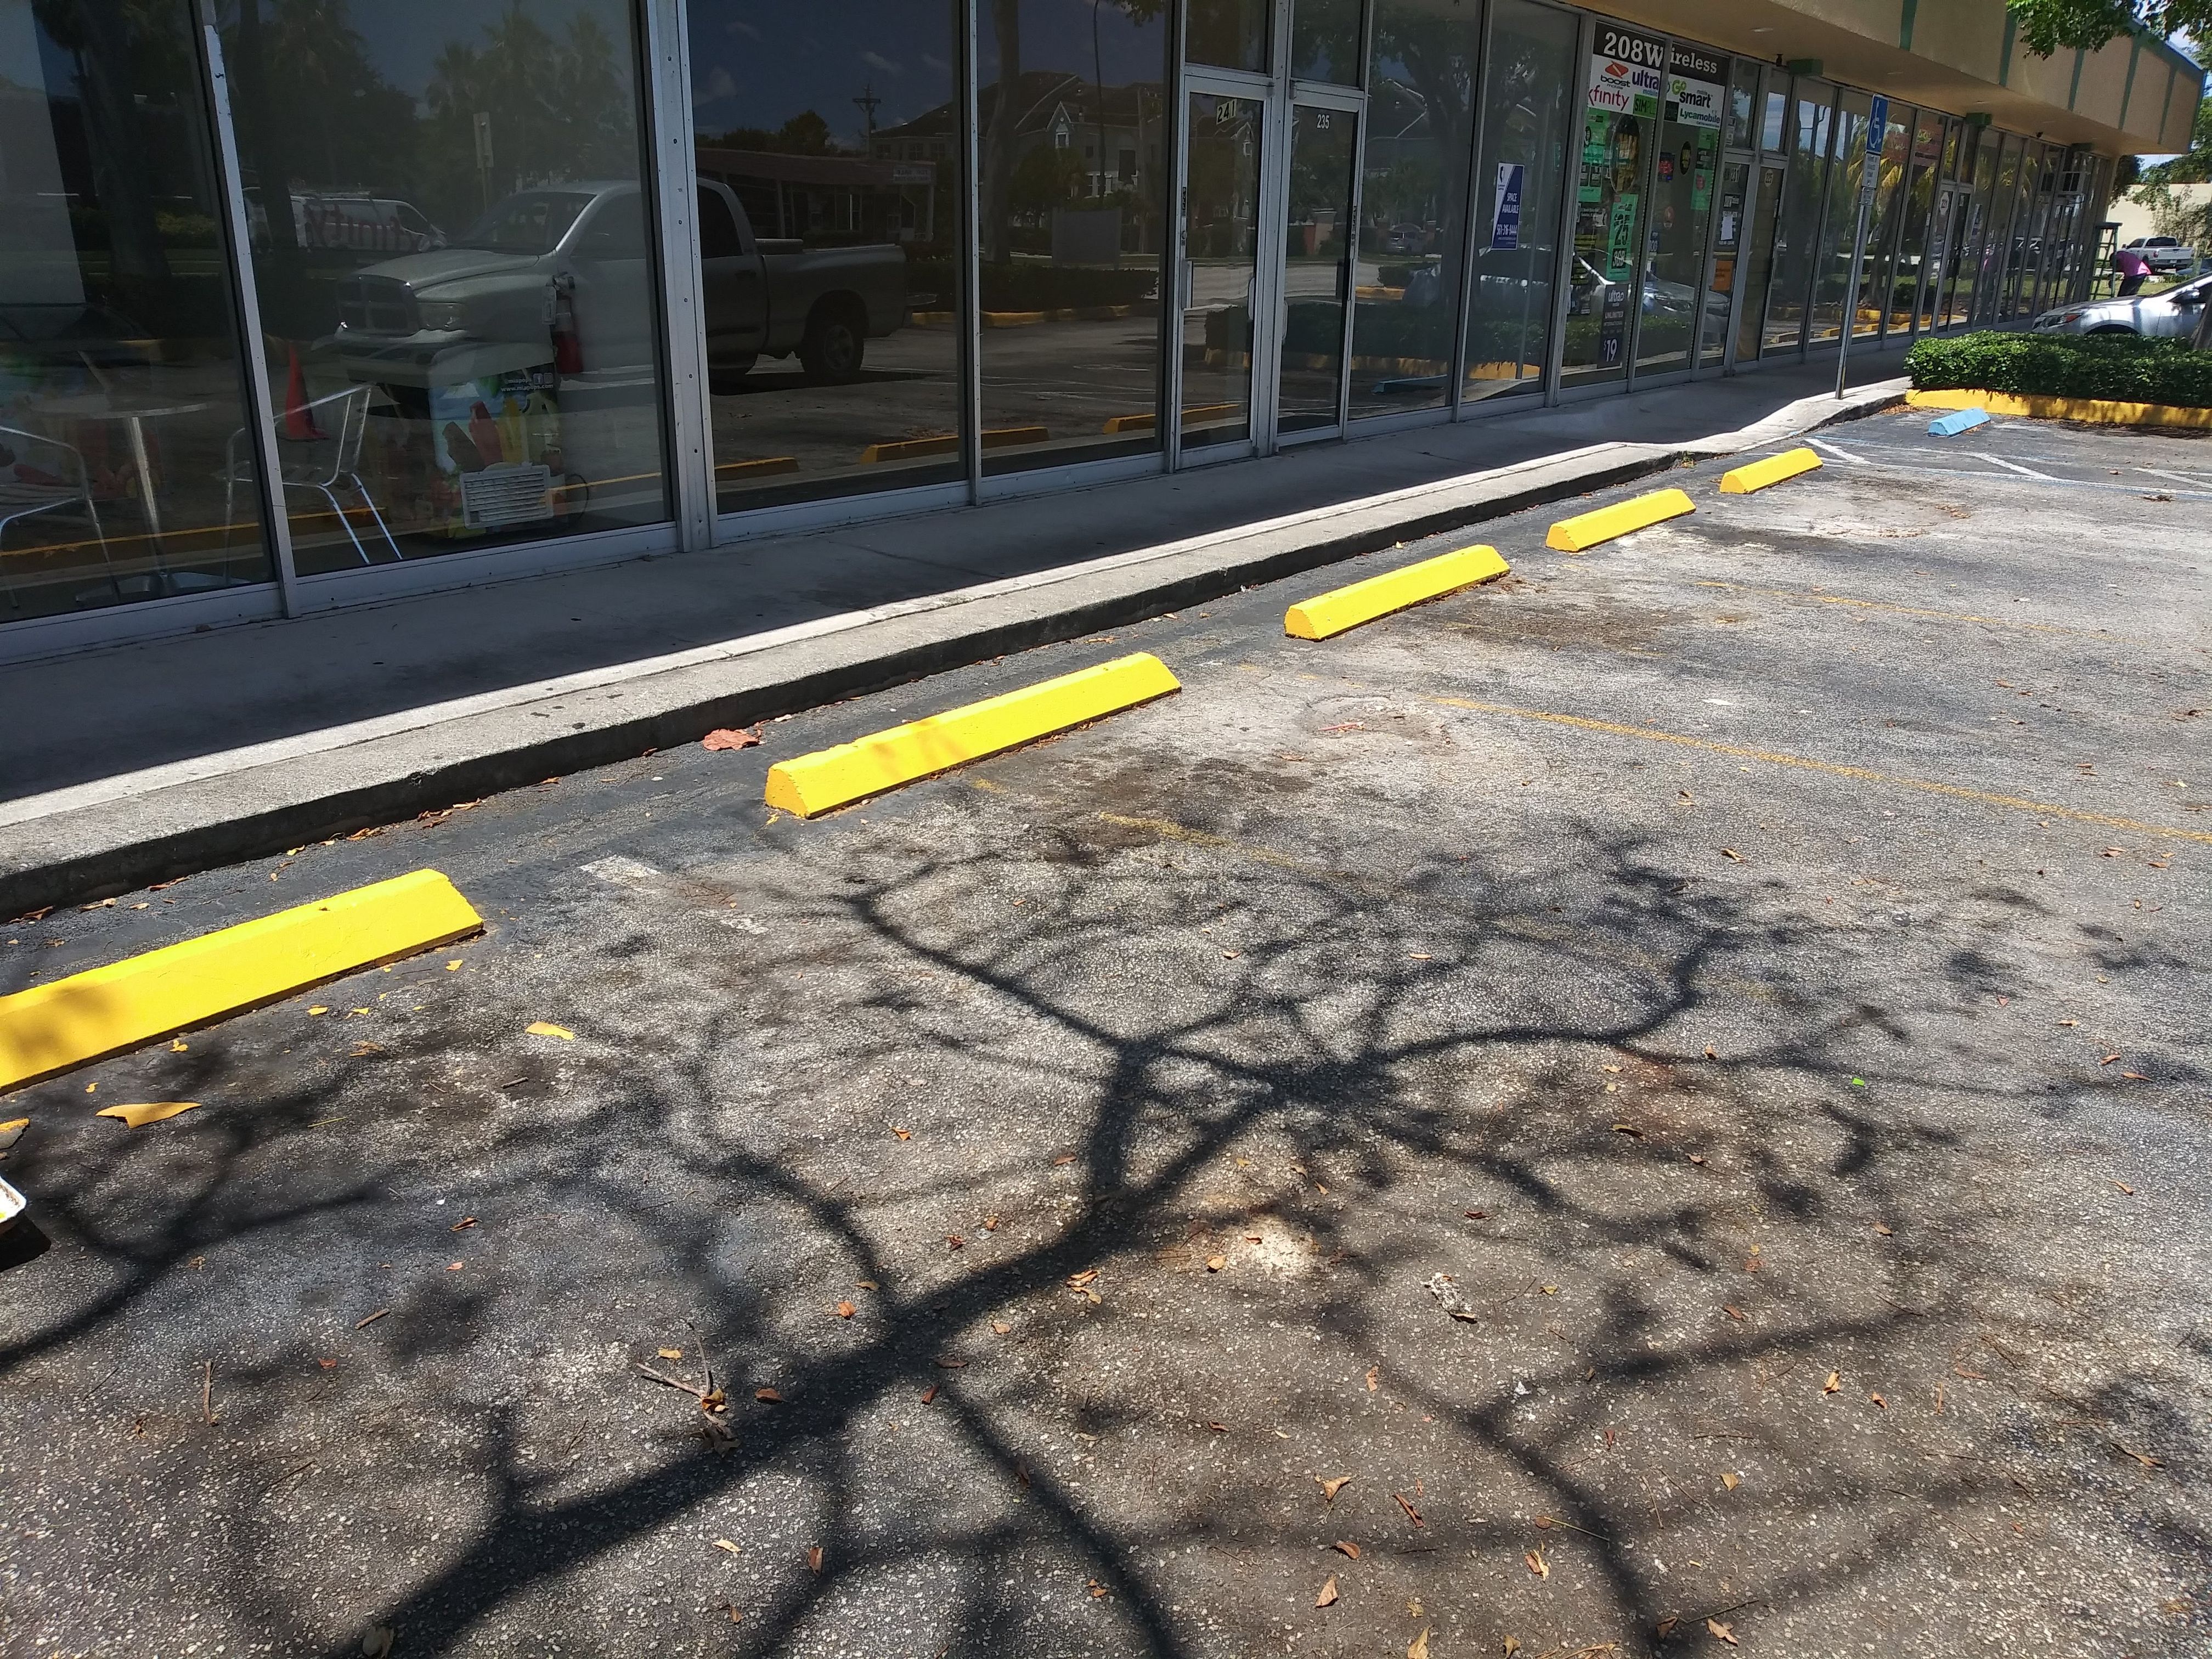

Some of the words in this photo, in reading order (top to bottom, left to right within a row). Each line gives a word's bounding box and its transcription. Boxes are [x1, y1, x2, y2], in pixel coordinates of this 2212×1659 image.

[1600, 75, 1631, 88] boost
[1632, 70, 1660, 90] ultra
[1679, 91, 1711, 108] smart
[1217, 100, 1235, 123] 241
[1680, 108, 1721, 124] Lycamobile
[1317, 114, 1330, 129] 235
[1506, 193, 1517, 202] SPACE
[1502, 204, 1519, 214] AVAILABLE
